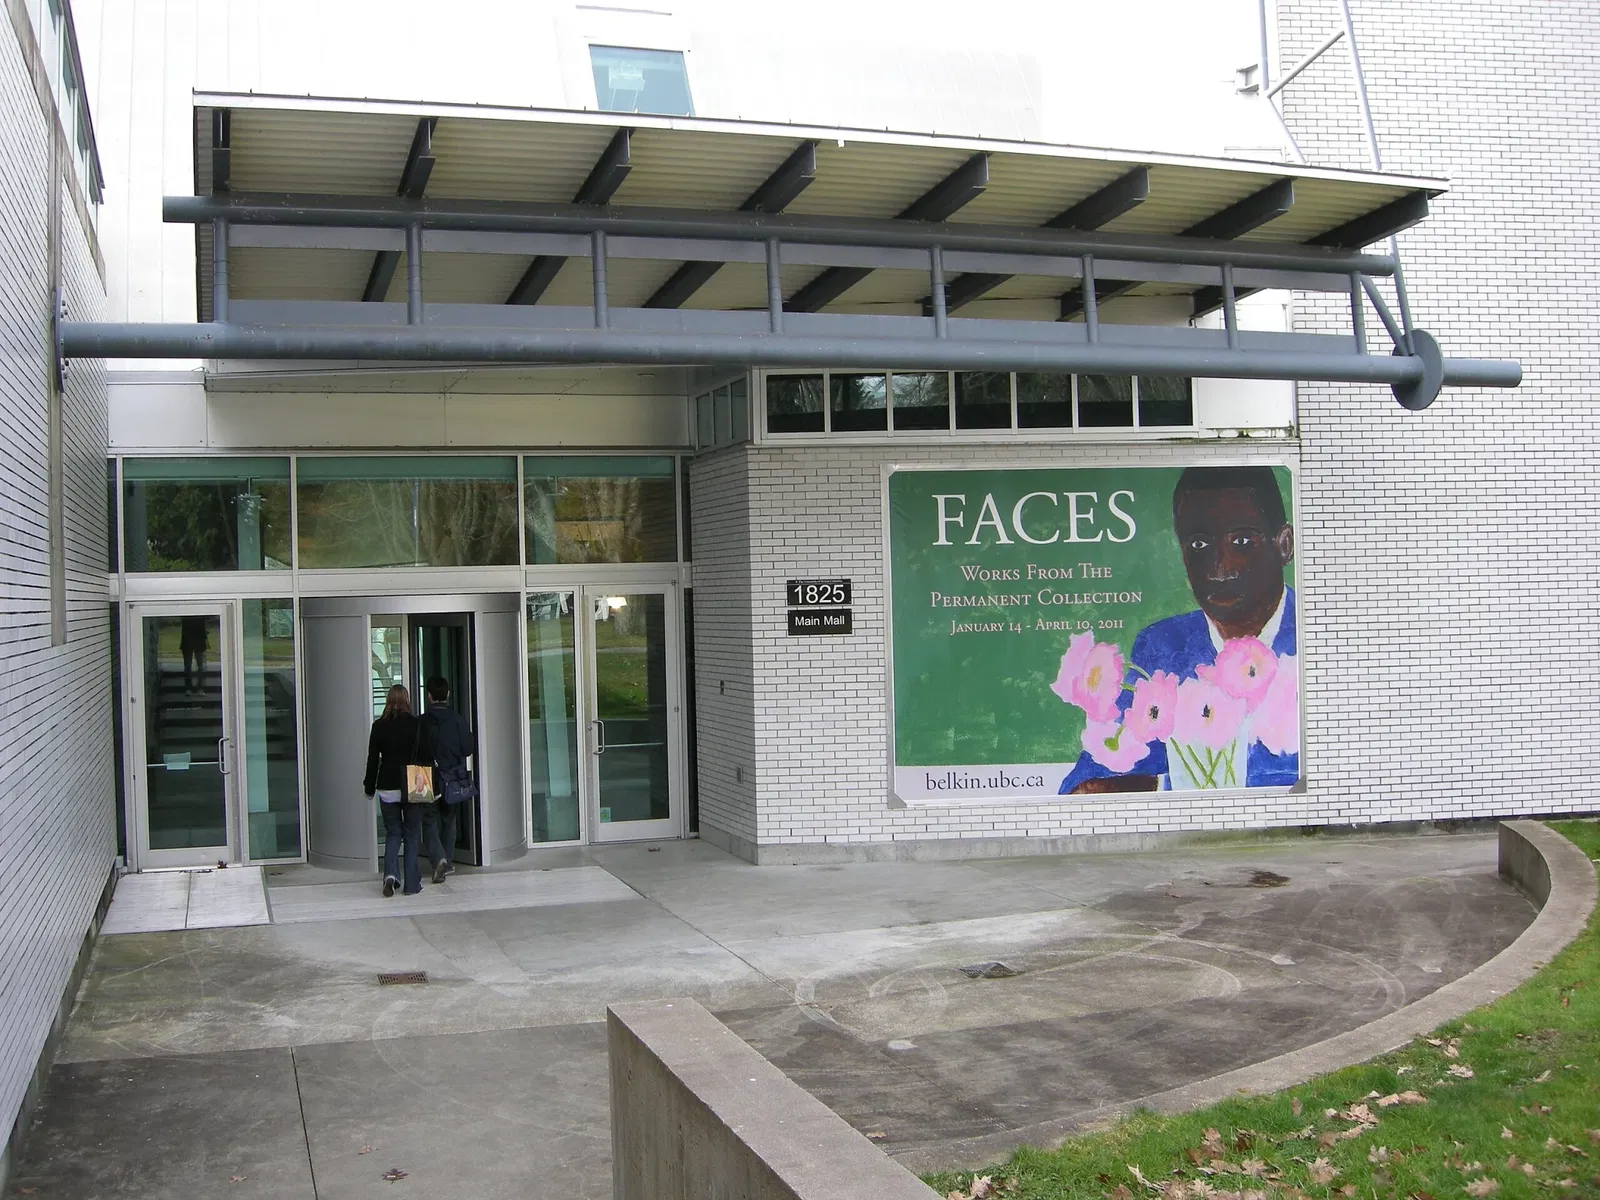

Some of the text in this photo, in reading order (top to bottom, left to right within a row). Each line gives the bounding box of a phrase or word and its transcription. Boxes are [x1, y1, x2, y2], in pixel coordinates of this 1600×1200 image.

[932, 490, 1137, 546] FACES
[960, 562, 1113, 581] WORKS FROM THE
[794, 584, 845, 604] 1825
[930, 588, 1143, 608] PERMANENT COLLECTION
[795, 615, 845, 626] Main Mall
[950, 620, 1005, 635] JANUARY
[1008, 621, 1022, 633] 14
[1035, 618, 1072, 631] APRIL
[1076, 619, 1093, 631] 10,
[1098, 619, 1124, 630] 2011
[925, 770, 1045, 790] belkin.ubc.ca
